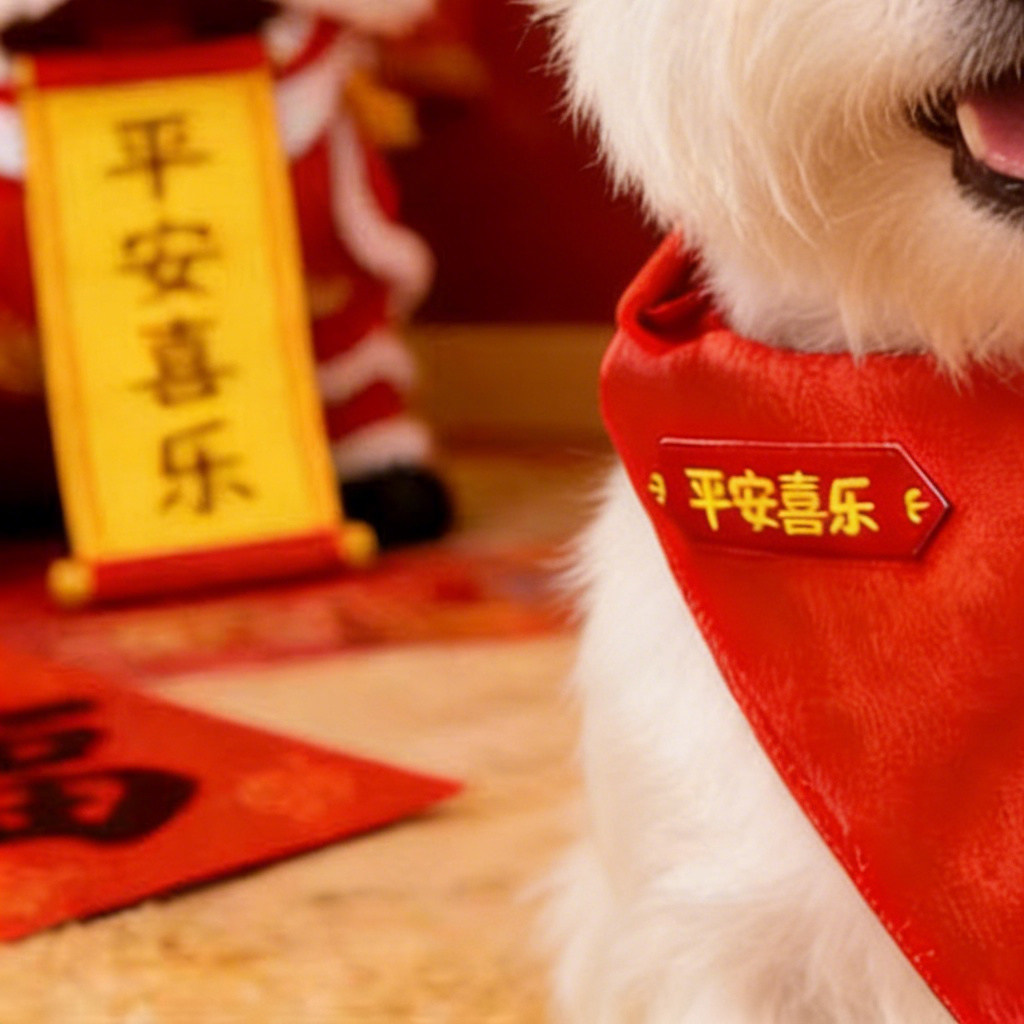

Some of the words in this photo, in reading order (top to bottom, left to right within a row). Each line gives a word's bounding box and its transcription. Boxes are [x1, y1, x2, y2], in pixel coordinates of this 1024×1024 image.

[106, 112, 257, 516] 平安喜乐
[684, 467, 880, 537] 平安喜乐
